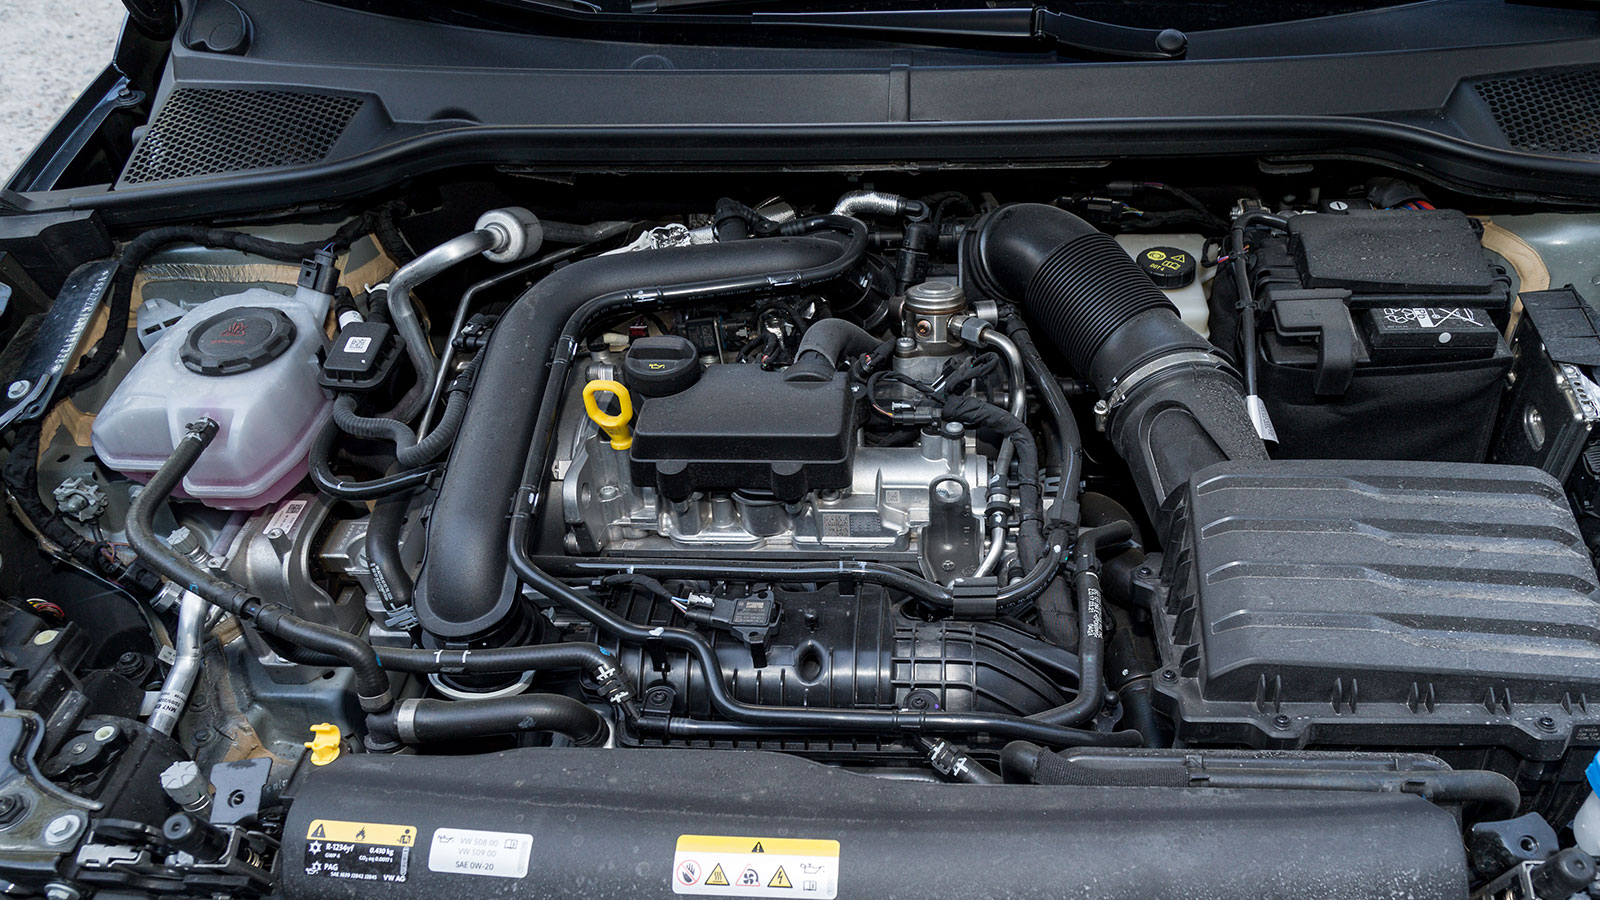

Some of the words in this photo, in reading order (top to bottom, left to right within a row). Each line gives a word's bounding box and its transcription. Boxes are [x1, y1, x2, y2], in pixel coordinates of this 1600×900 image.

[474, 838, 487, 846] 508
[488, 839, 499, 847] 00
[325, 843, 355, 853] R-1234yf
[386, 848, 394, 856] kg
[472, 848, 485, 856] 509
[324, 863, 338, 871] PAG
[470, 862, 494, 870] 0W-20
